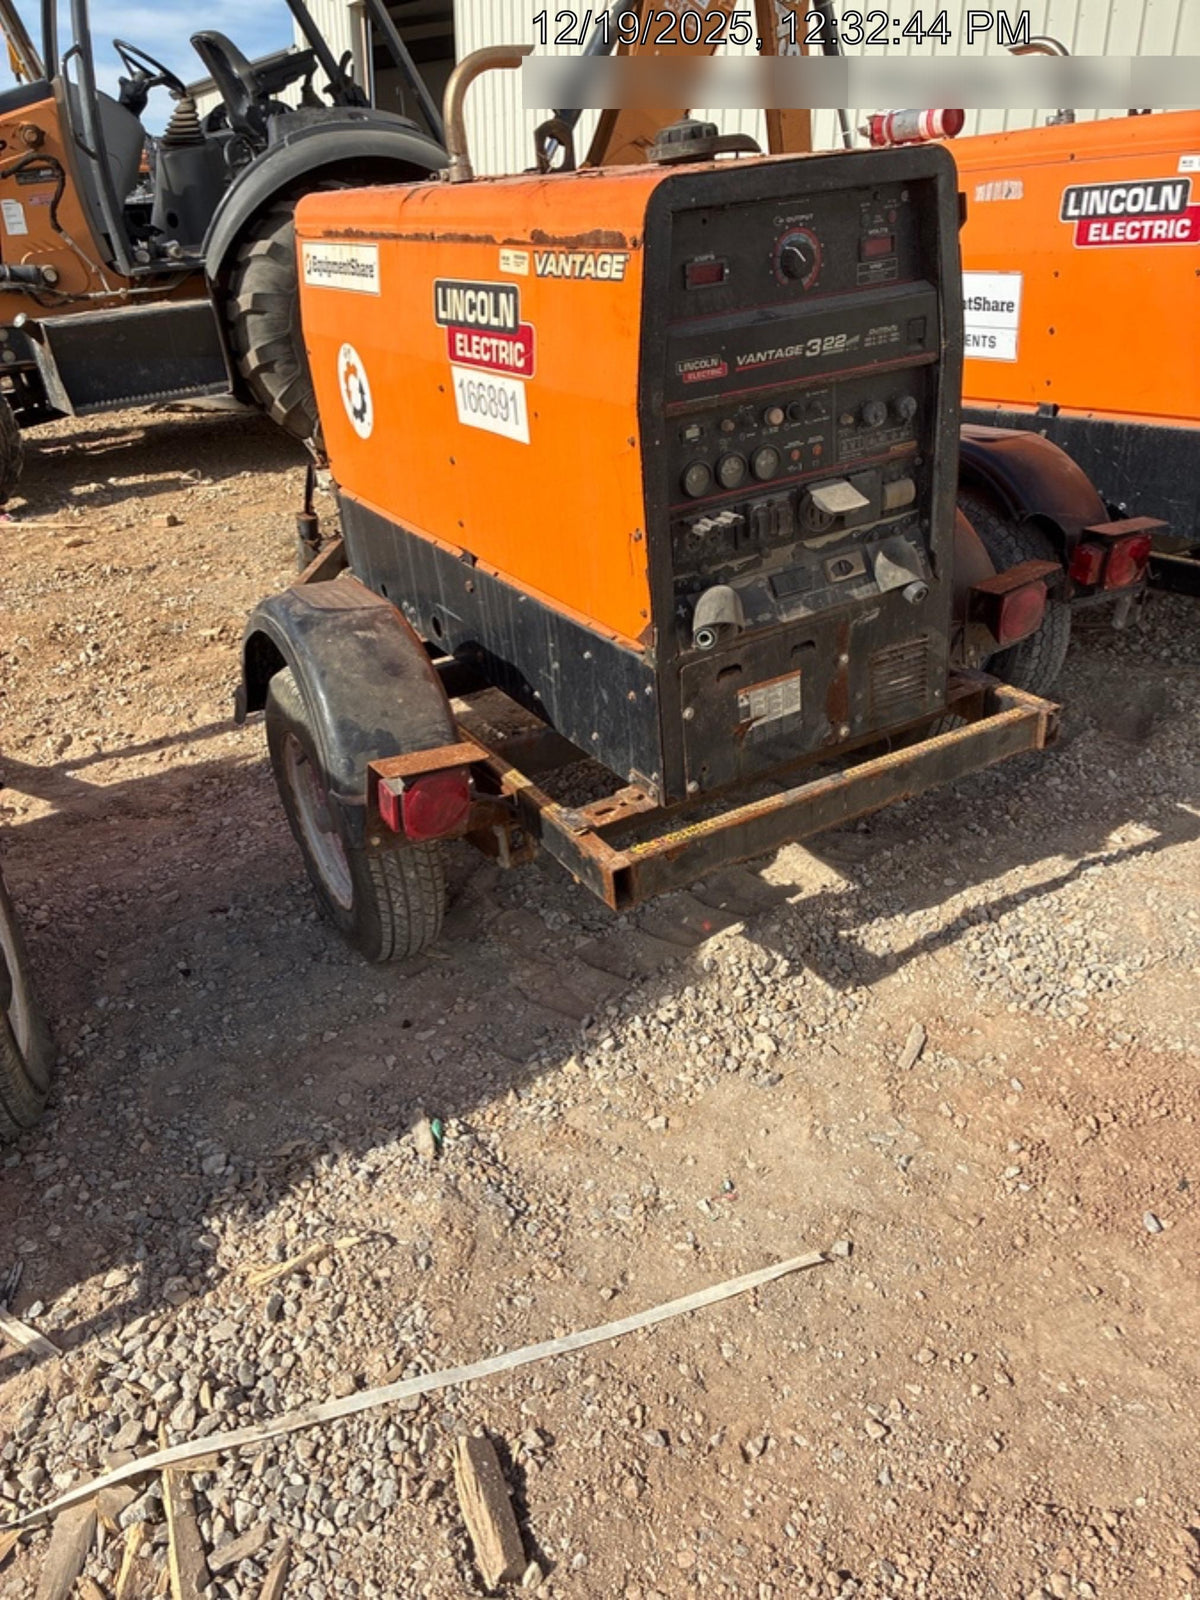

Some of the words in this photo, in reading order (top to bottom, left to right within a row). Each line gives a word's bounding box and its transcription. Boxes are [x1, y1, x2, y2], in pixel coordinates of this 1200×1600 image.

[1066, 184, 1183, 217] LINCOLN
[1087, 218, 1192, 242] ELECTRIC
[533, 251, 630, 281] VANTAGE
[437, 287, 515, 329] LINCOLN
[455, 332, 526, 369] ELECTRIC
[678, 357, 719, 373] LINCOLN
[736, 344, 804, 366] VANTAGE
[804, 333, 847, 357] 322
[458, 378, 520, 426] 166891
